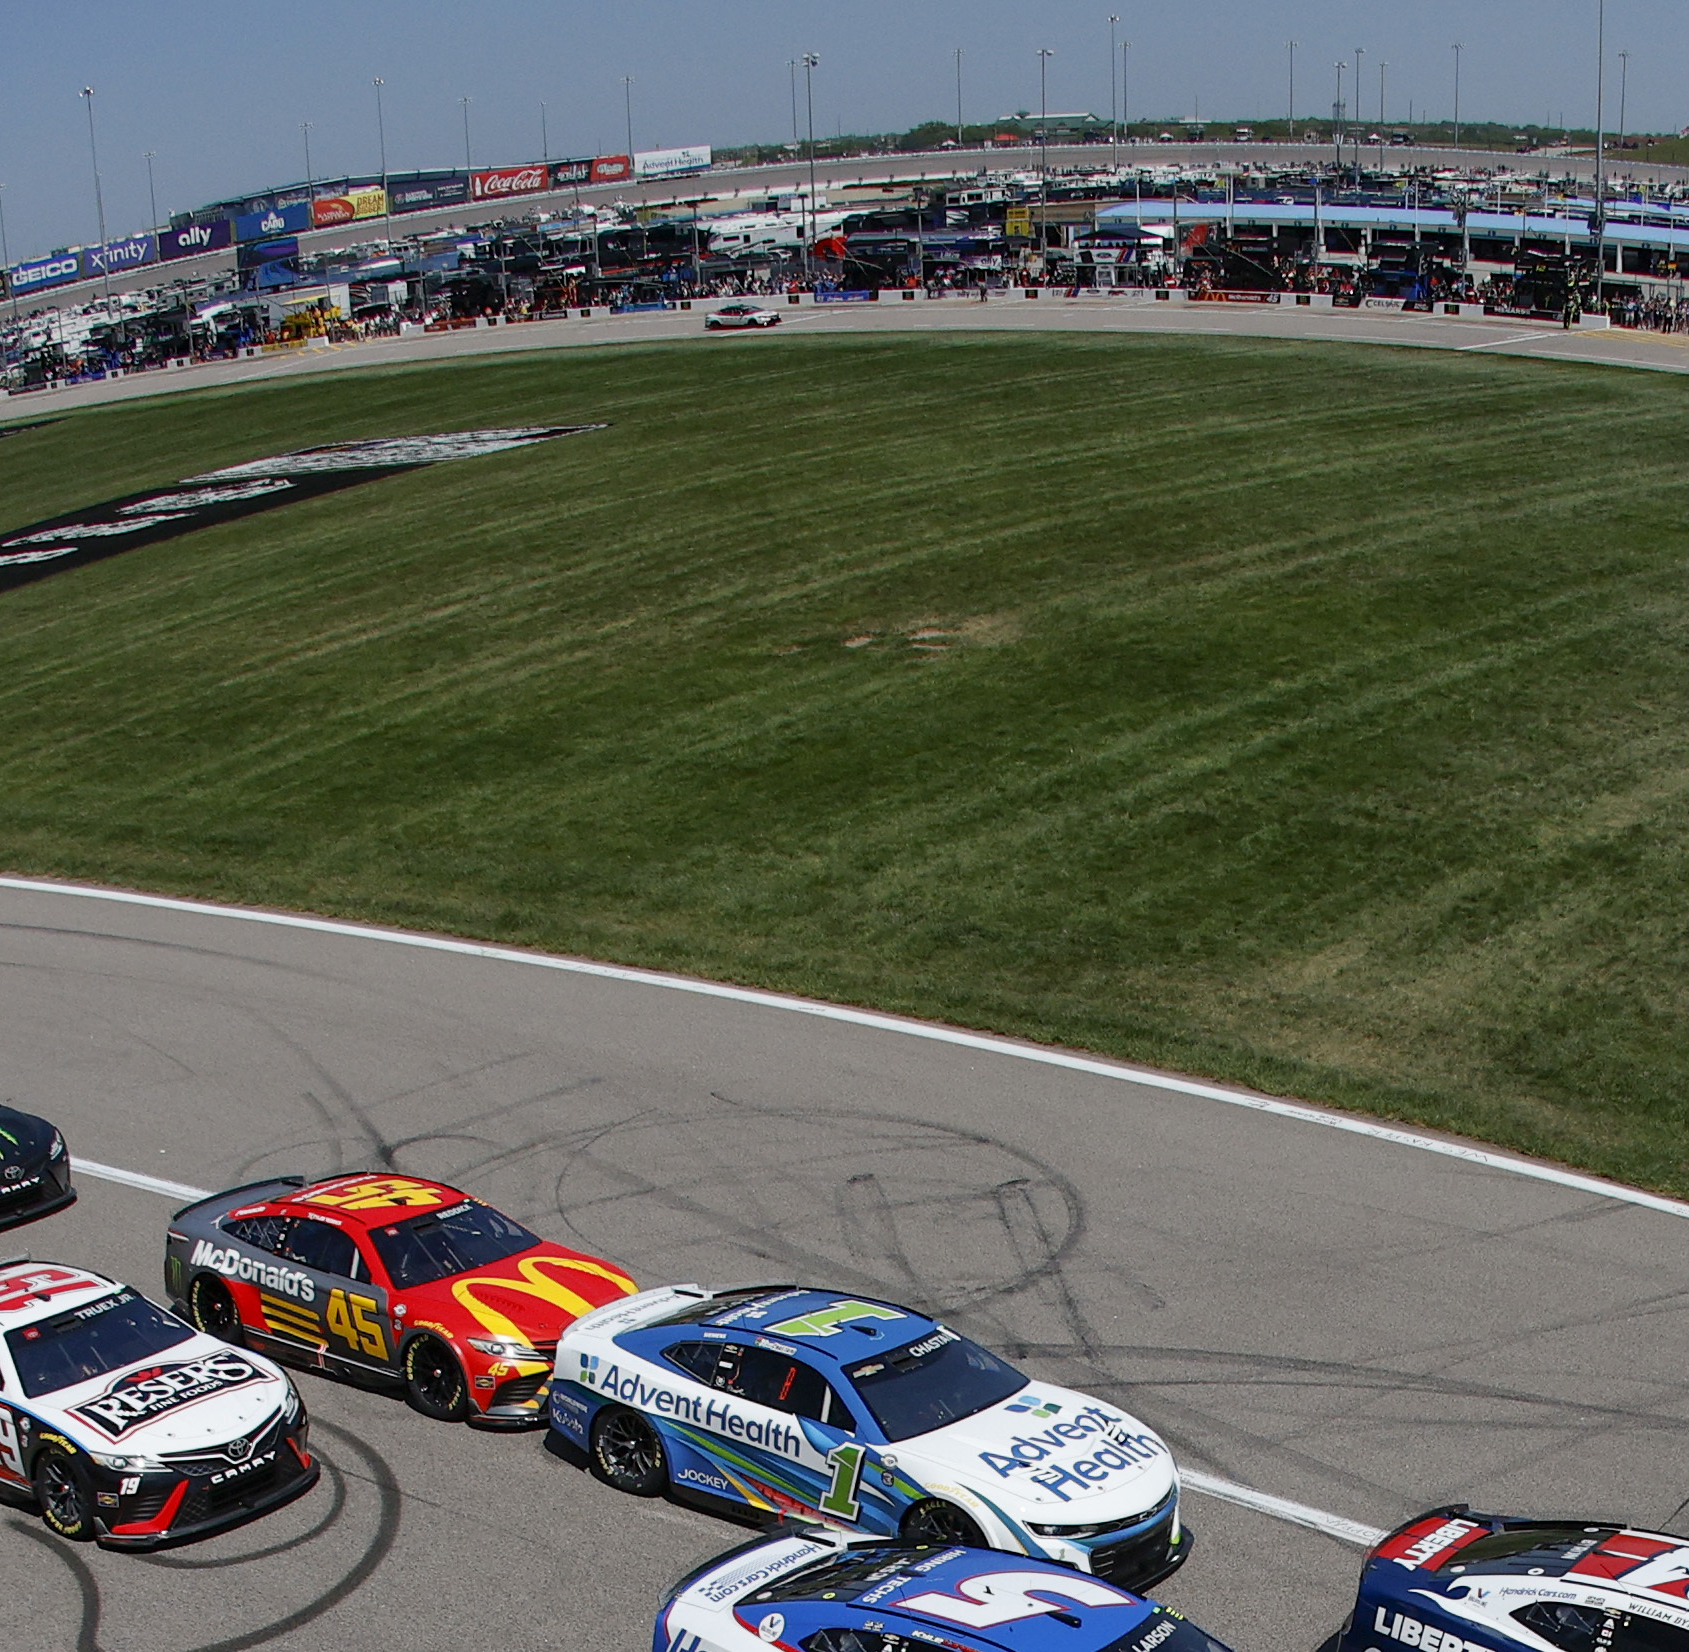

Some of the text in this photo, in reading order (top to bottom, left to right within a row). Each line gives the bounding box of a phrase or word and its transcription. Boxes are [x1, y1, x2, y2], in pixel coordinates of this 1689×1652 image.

[484, 170, 543, 193] Coca-Cola
[178, 227, 211, 247] ally
[91, 243, 148, 269] xfinity
[12, 261, 78, 287] GEICO
[191, 1239, 316, 1302] McDonald's
[75, 1299, 117, 1321] TRUEX
[326, 1288, 389, 1362] 45
[488, 1362, 510, 1377] 45
[87, 1350, 258, 1431] RESER'S
[148, 1379, 224, 1413] FINE FOODS
[600, 1365, 801, 1458] AdventHealth
[979, 1406, 1123, 1479] Advent
[211, 1450, 277, 1485] CAMRY
[677, 1468, 730, 1490] JOCKEY
[1031, 1430, 1169, 1502] Health
[119, 1477, 140, 1496] 19
[819, 1443, 865, 1521] 1
[1393, 1518, 1479, 1571] LIBERTY
[914, 1549, 967, 1574] HIRING
[863, 1575, 912, 1604] TECHS
[892, 1571, 1136, 1629] 5
[1628, 1602, 1673, 1622] WILLIAM
